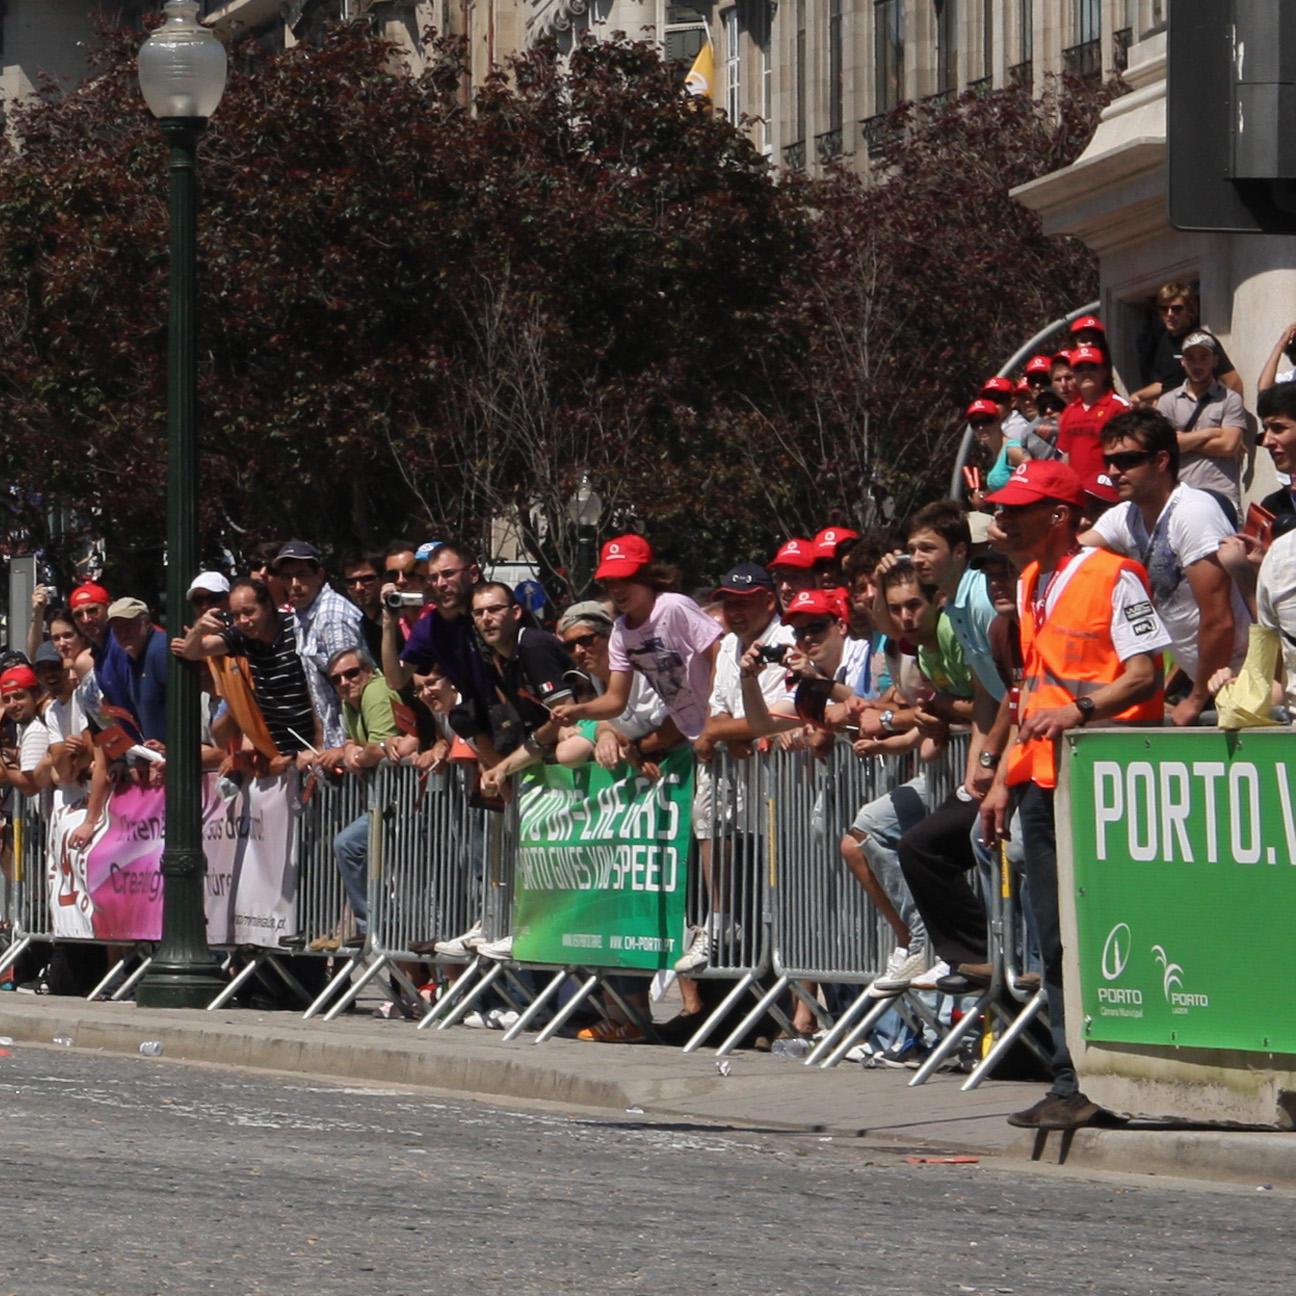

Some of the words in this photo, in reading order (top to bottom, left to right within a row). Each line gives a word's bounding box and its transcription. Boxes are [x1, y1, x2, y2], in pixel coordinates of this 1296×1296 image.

[613, 844, 678, 893] SPEED
[1097, 988, 1143, 1005] PORTO
[1171, 992, 1209, 1007] PORTO
